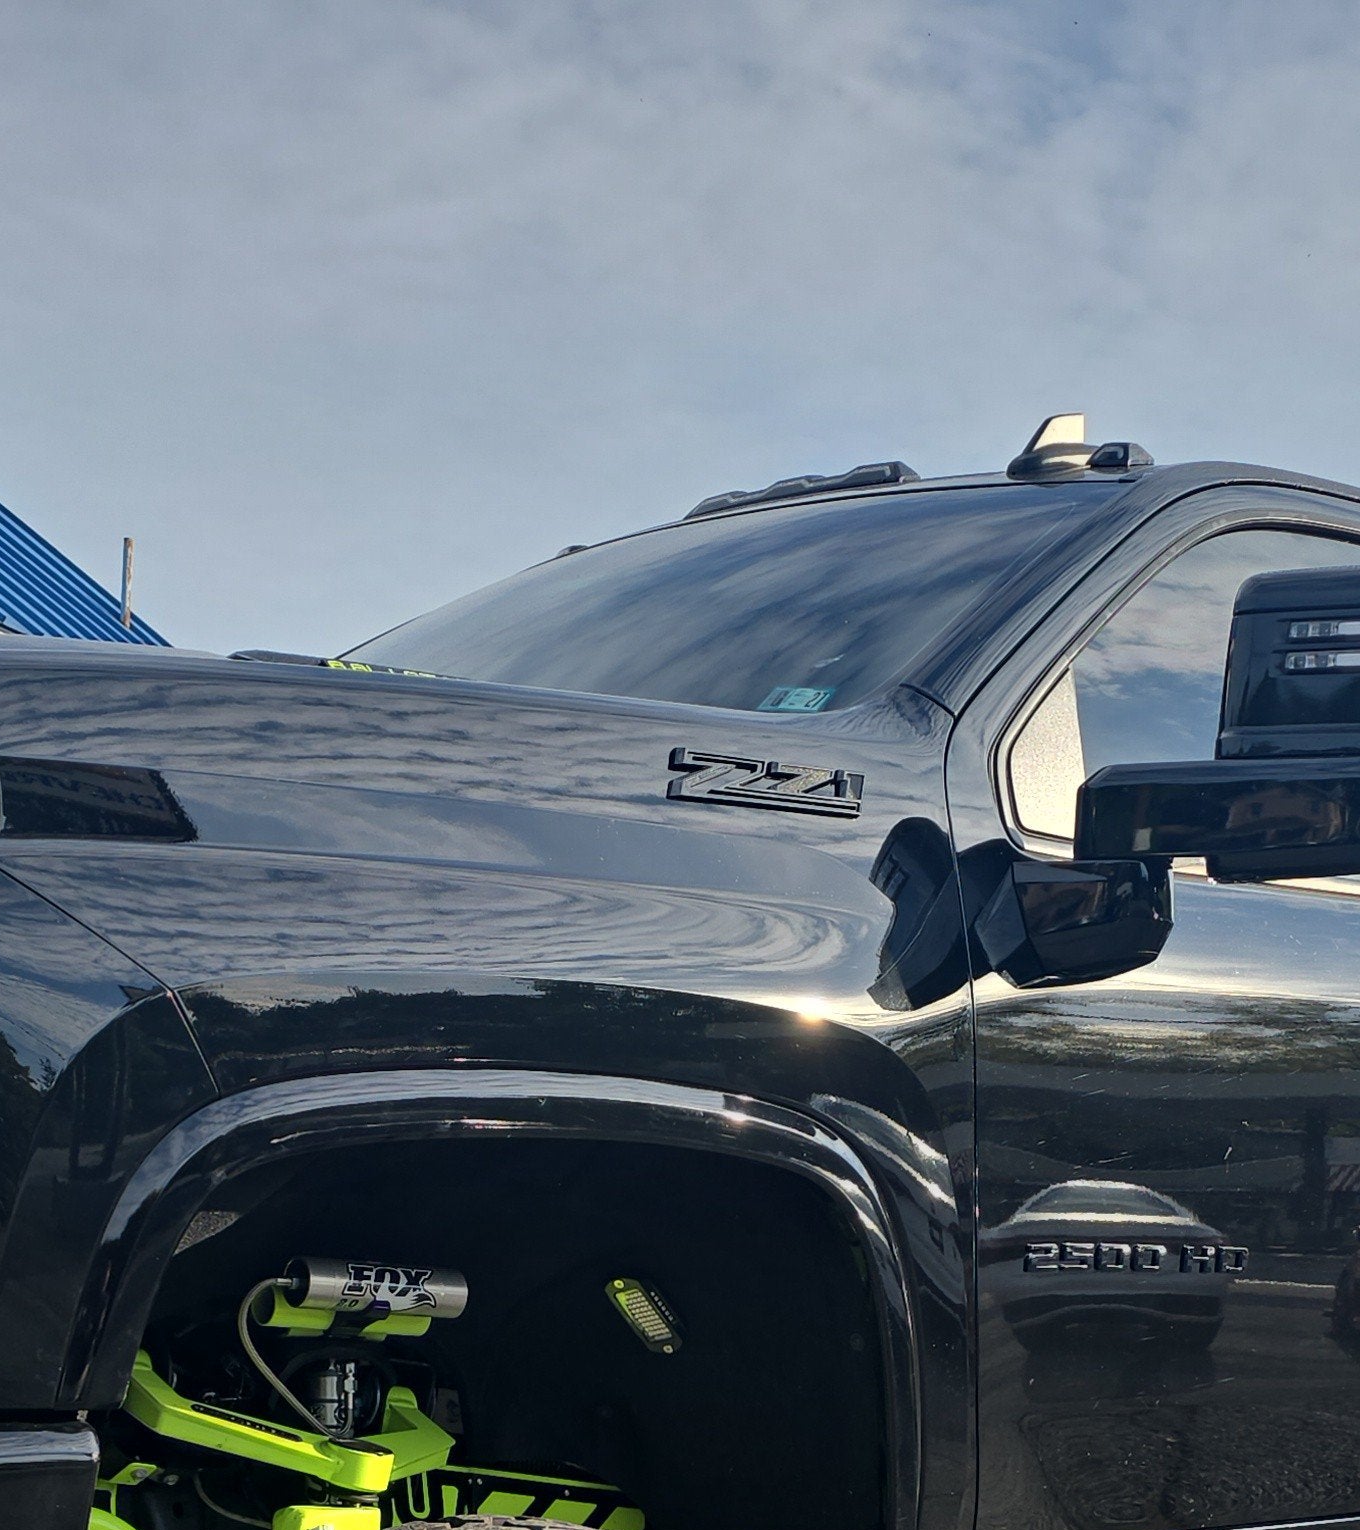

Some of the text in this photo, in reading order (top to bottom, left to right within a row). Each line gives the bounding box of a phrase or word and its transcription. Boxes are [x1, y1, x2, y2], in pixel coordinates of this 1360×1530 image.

[666, 747, 865, 819] Z71
[1022, 1241, 1250, 1274] 2500 HD
[341, 1262, 436, 1305] FOX
